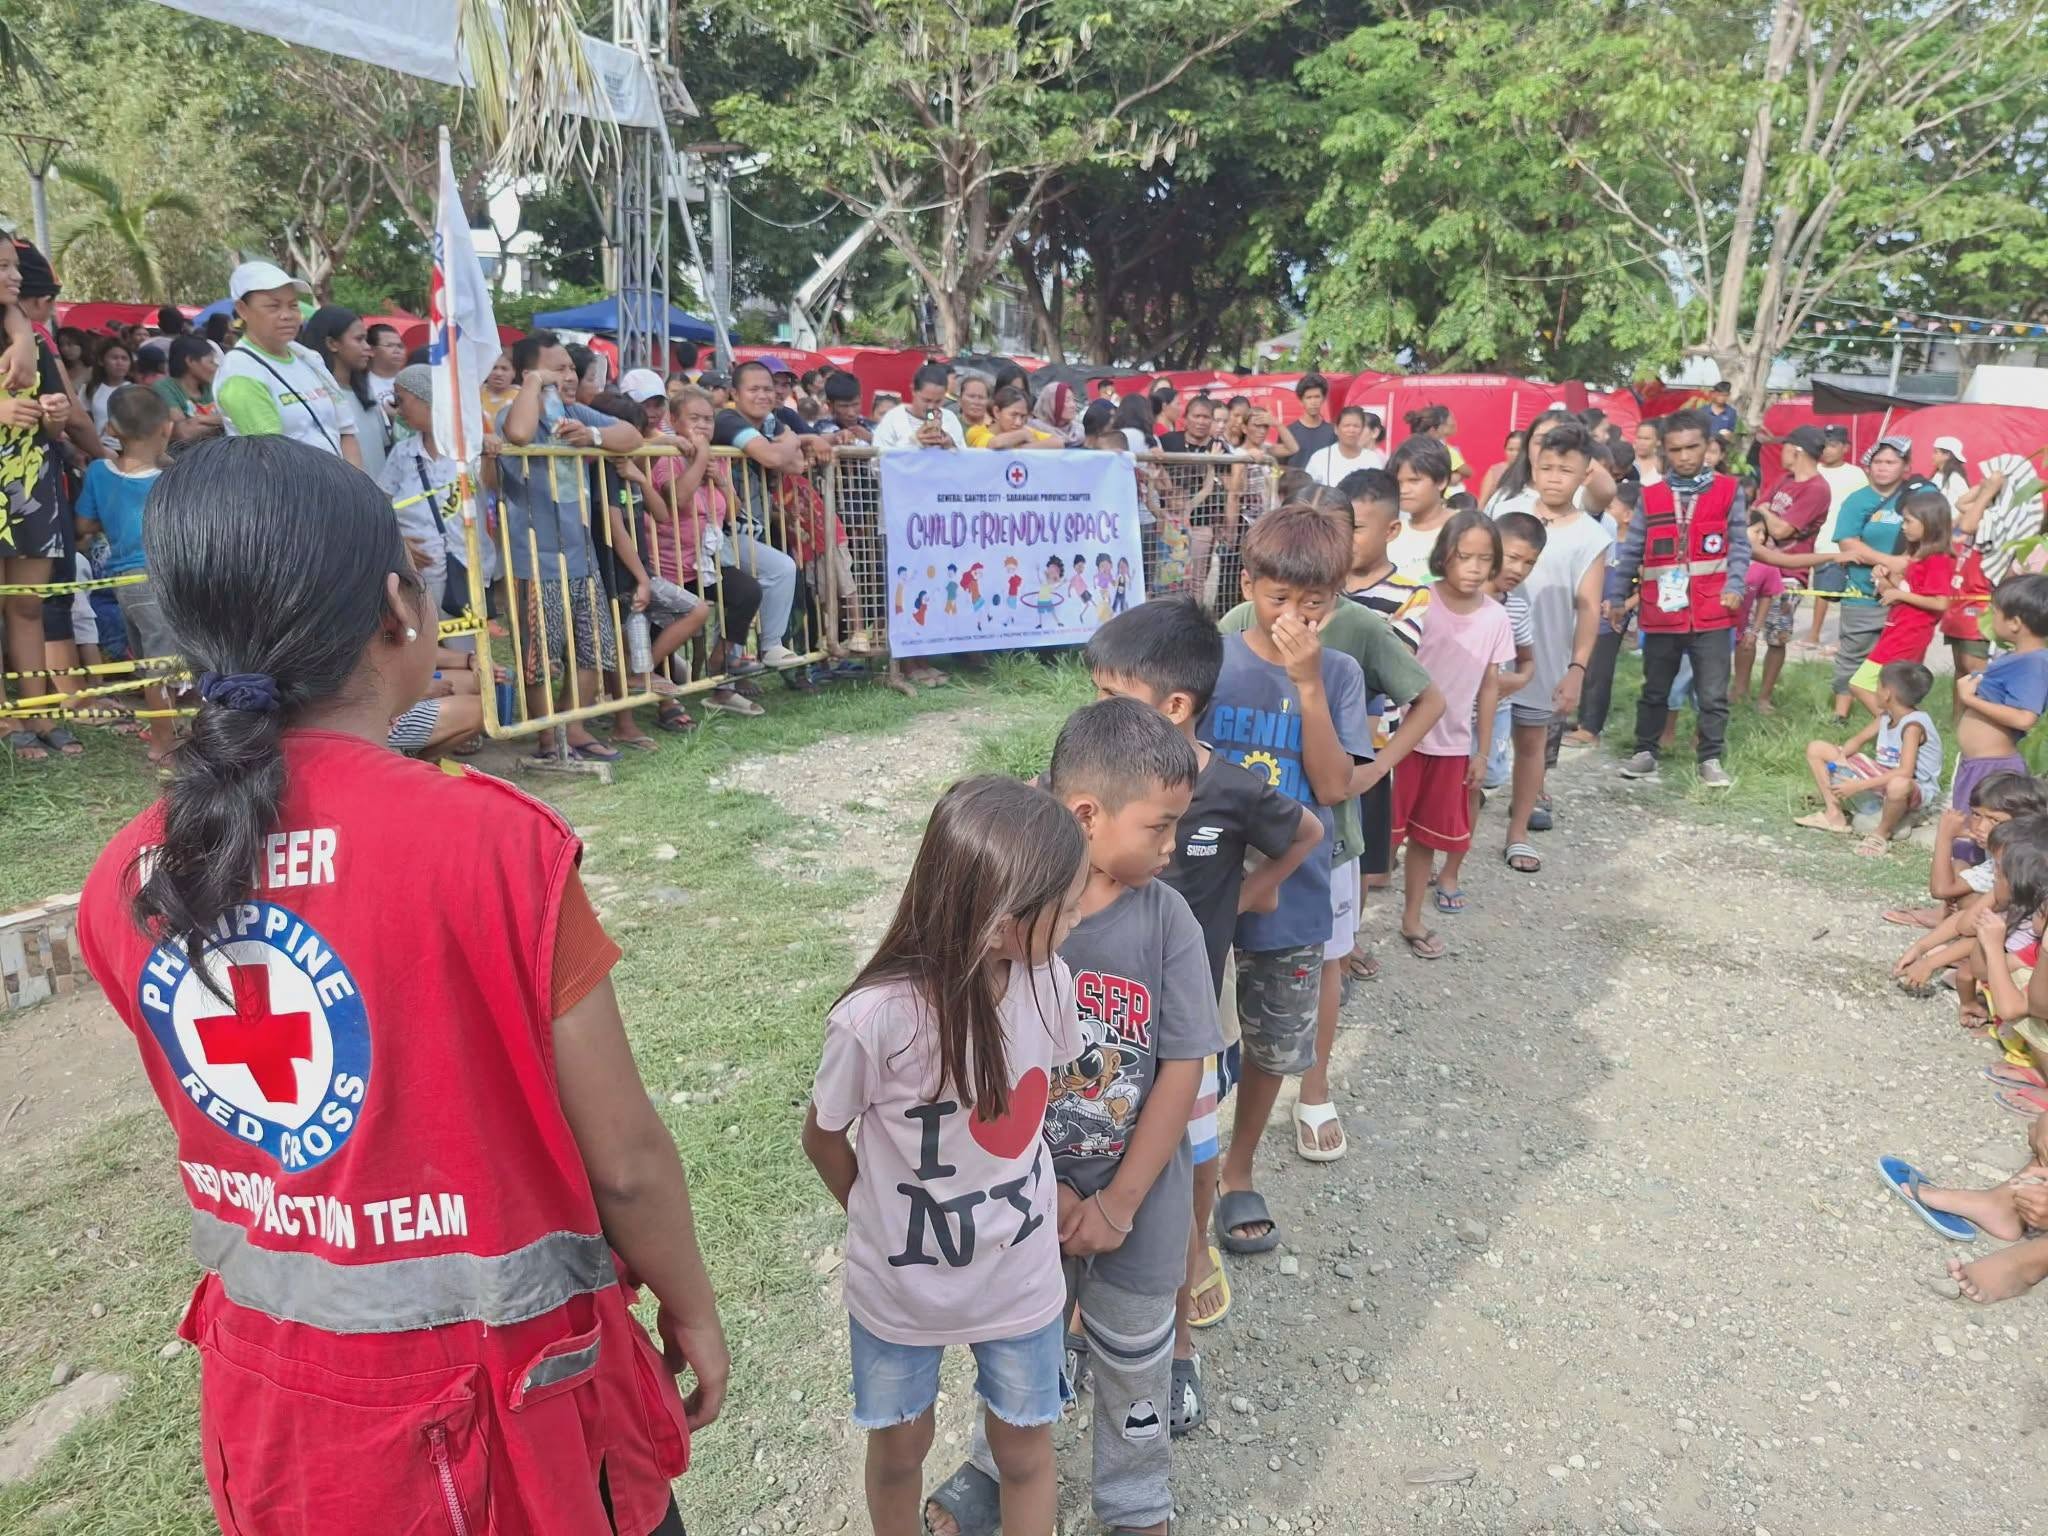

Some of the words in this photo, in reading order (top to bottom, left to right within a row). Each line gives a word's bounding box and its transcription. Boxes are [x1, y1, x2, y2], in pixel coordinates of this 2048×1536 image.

[906, 511, 967, 550] CHILD
[972, 511, 1061, 549] FRIENDLY
[1064, 510, 1120, 544] SPACE
[937, 493, 963, 503] GENERAL
[964, 493, 987, 503] SANTOS
[988, 493, 1001, 502] CITY
[1040, 493, 1067, 502] PROVINCE
[1068, 493, 1091, 501] CHAPTER
[1213, 704, 1302, 753] GENIU
[142, 903, 355, 1014] PHIPPINE
[181, 1072, 264, 1143] RED
[280, 1072, 365, 1168] CROSS
[904, 1101, 957, 1181] I
[180, 1160, 221, 1203] RED
[221, 1169, 277, 1227] CRO
[264, 1188, 356, 1249] ACTION
[363, 1193, 468, 1245] TEAM
